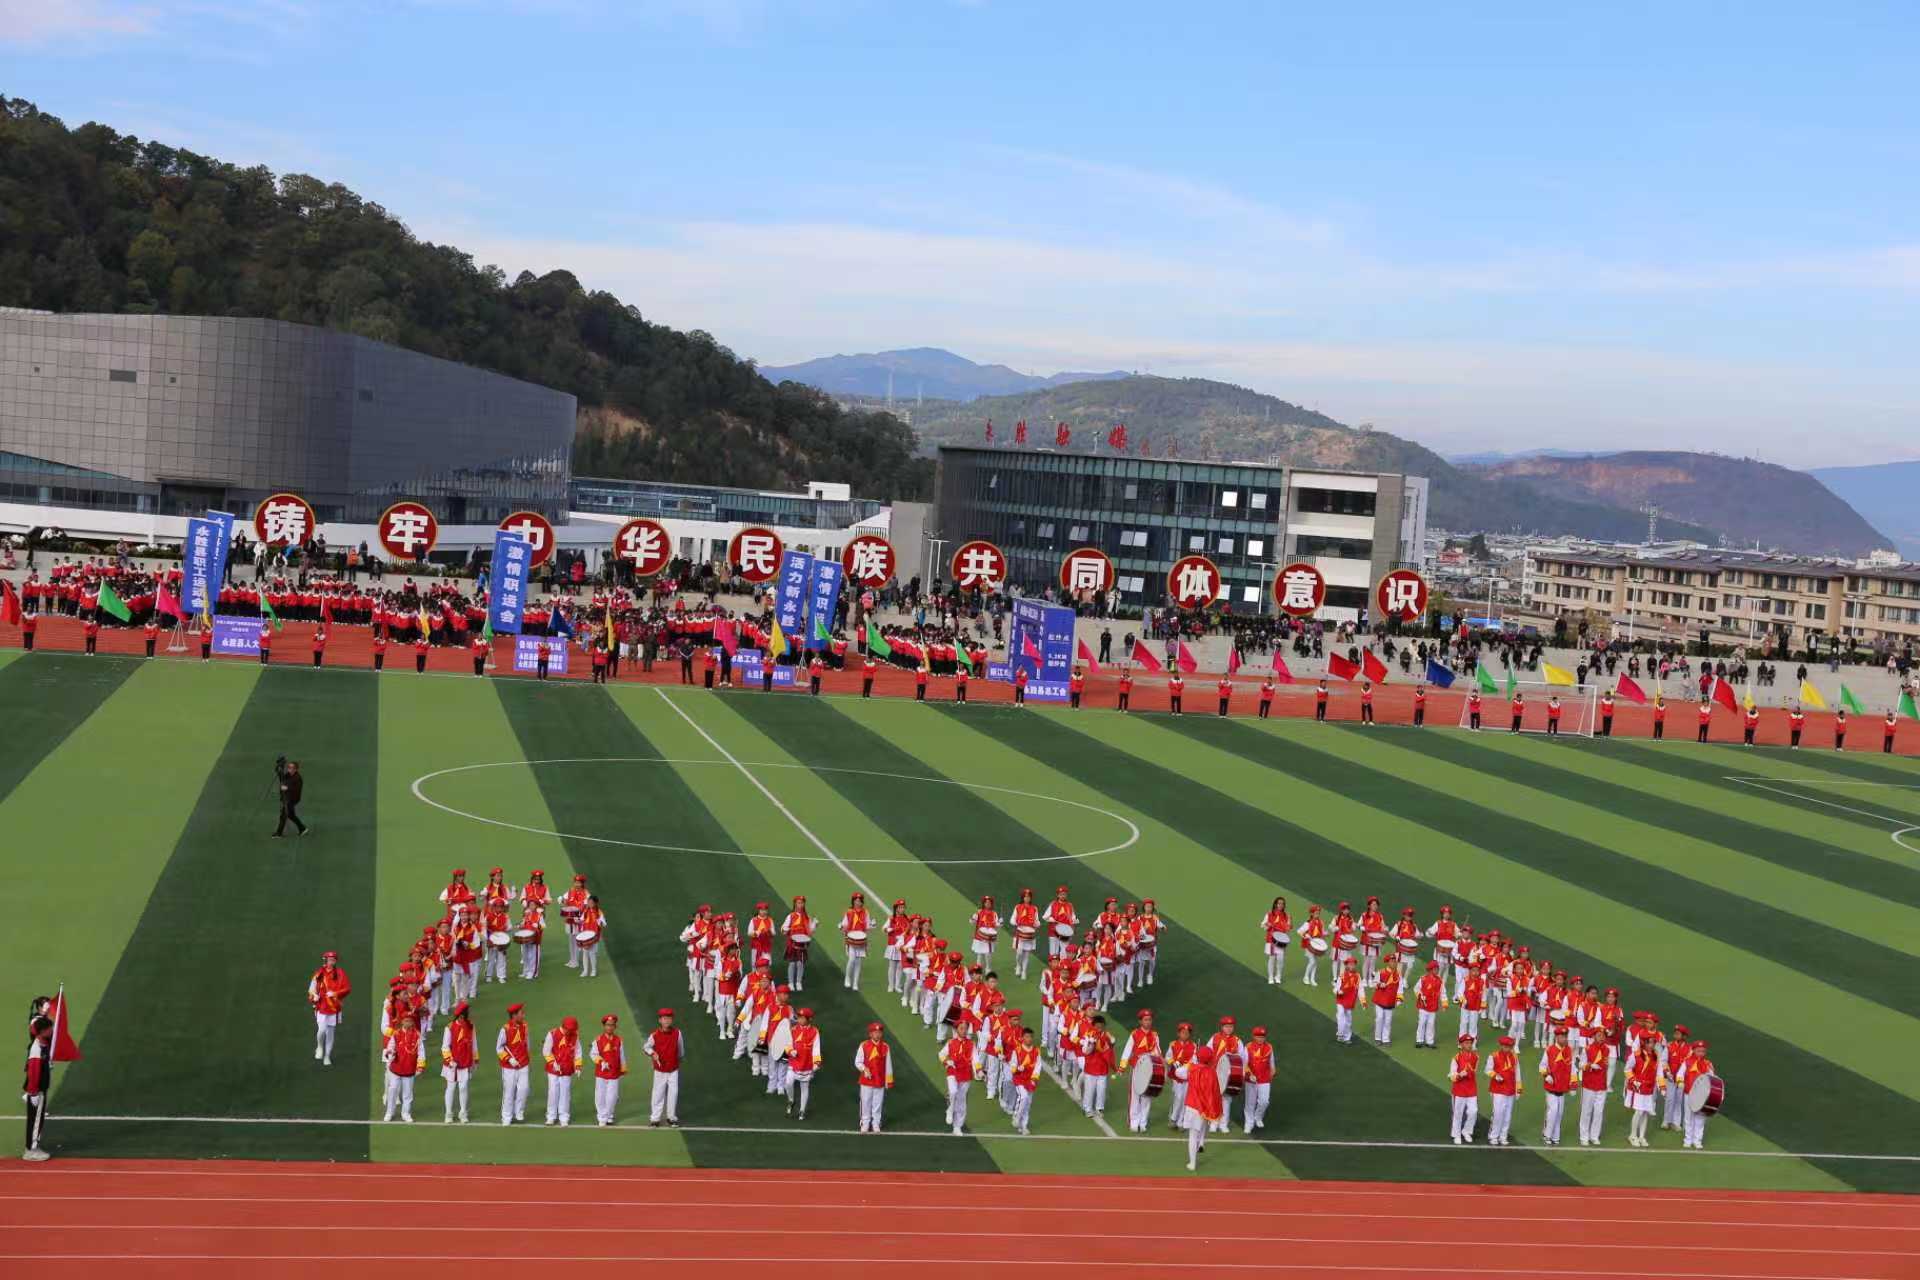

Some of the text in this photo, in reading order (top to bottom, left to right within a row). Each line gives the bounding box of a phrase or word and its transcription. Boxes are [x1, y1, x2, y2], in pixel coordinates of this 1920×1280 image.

[264, 502, 306, 544] 铸
[387, 511, 429, 552] 牢
[621, 526, 661, 568] 华
[740, 535, 775, 574] 民
[850, 541, 889, 581] 族
[500, 545, 525, 624] 激情职运会
[960, 548, 998, 587] 共
[1069, 556, 1105, 593] 同
[1177, 563, 1212, 602] 体
[781, 556, 806, 627] 活力新永胜
[1281, 570, 1318, 608] 意
[1386, 577, 1419, 614] 识
